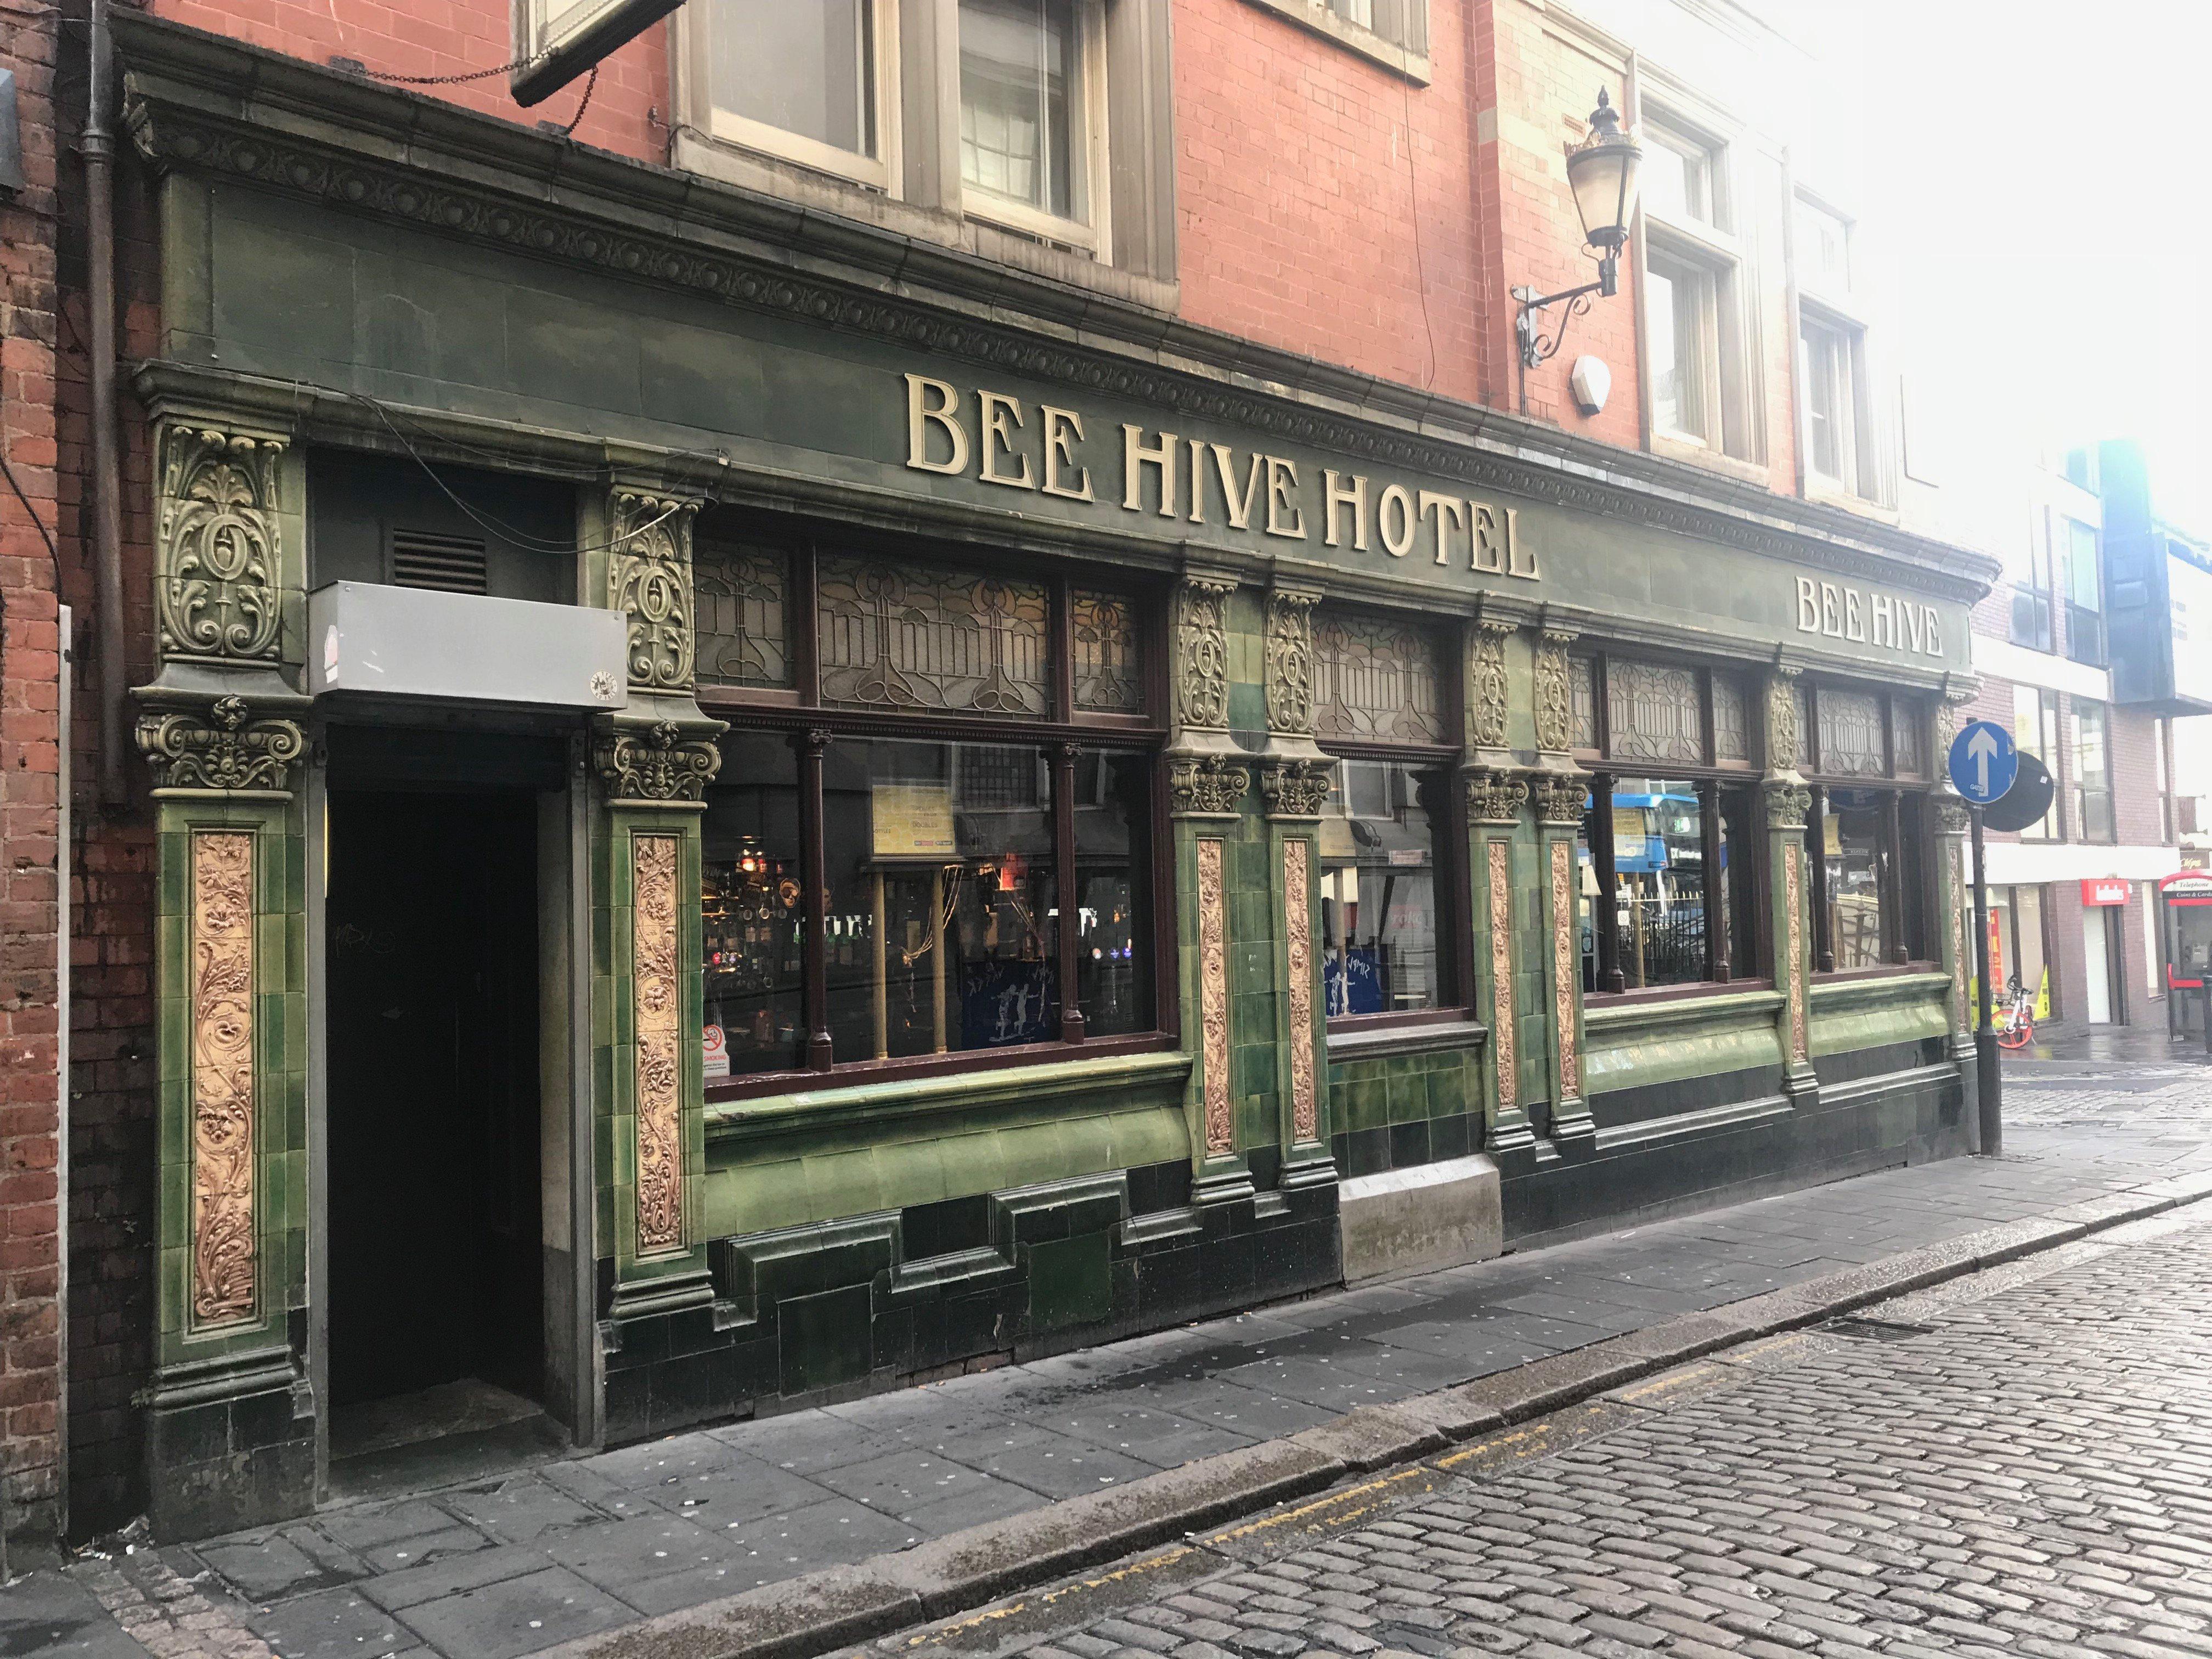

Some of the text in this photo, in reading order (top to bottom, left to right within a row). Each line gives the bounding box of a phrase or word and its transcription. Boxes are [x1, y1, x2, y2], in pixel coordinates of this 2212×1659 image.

[904, 373, 1542, 581] BEE HIVE HOTEL
[1795, 575, 1944, 658] BEE HIVE
